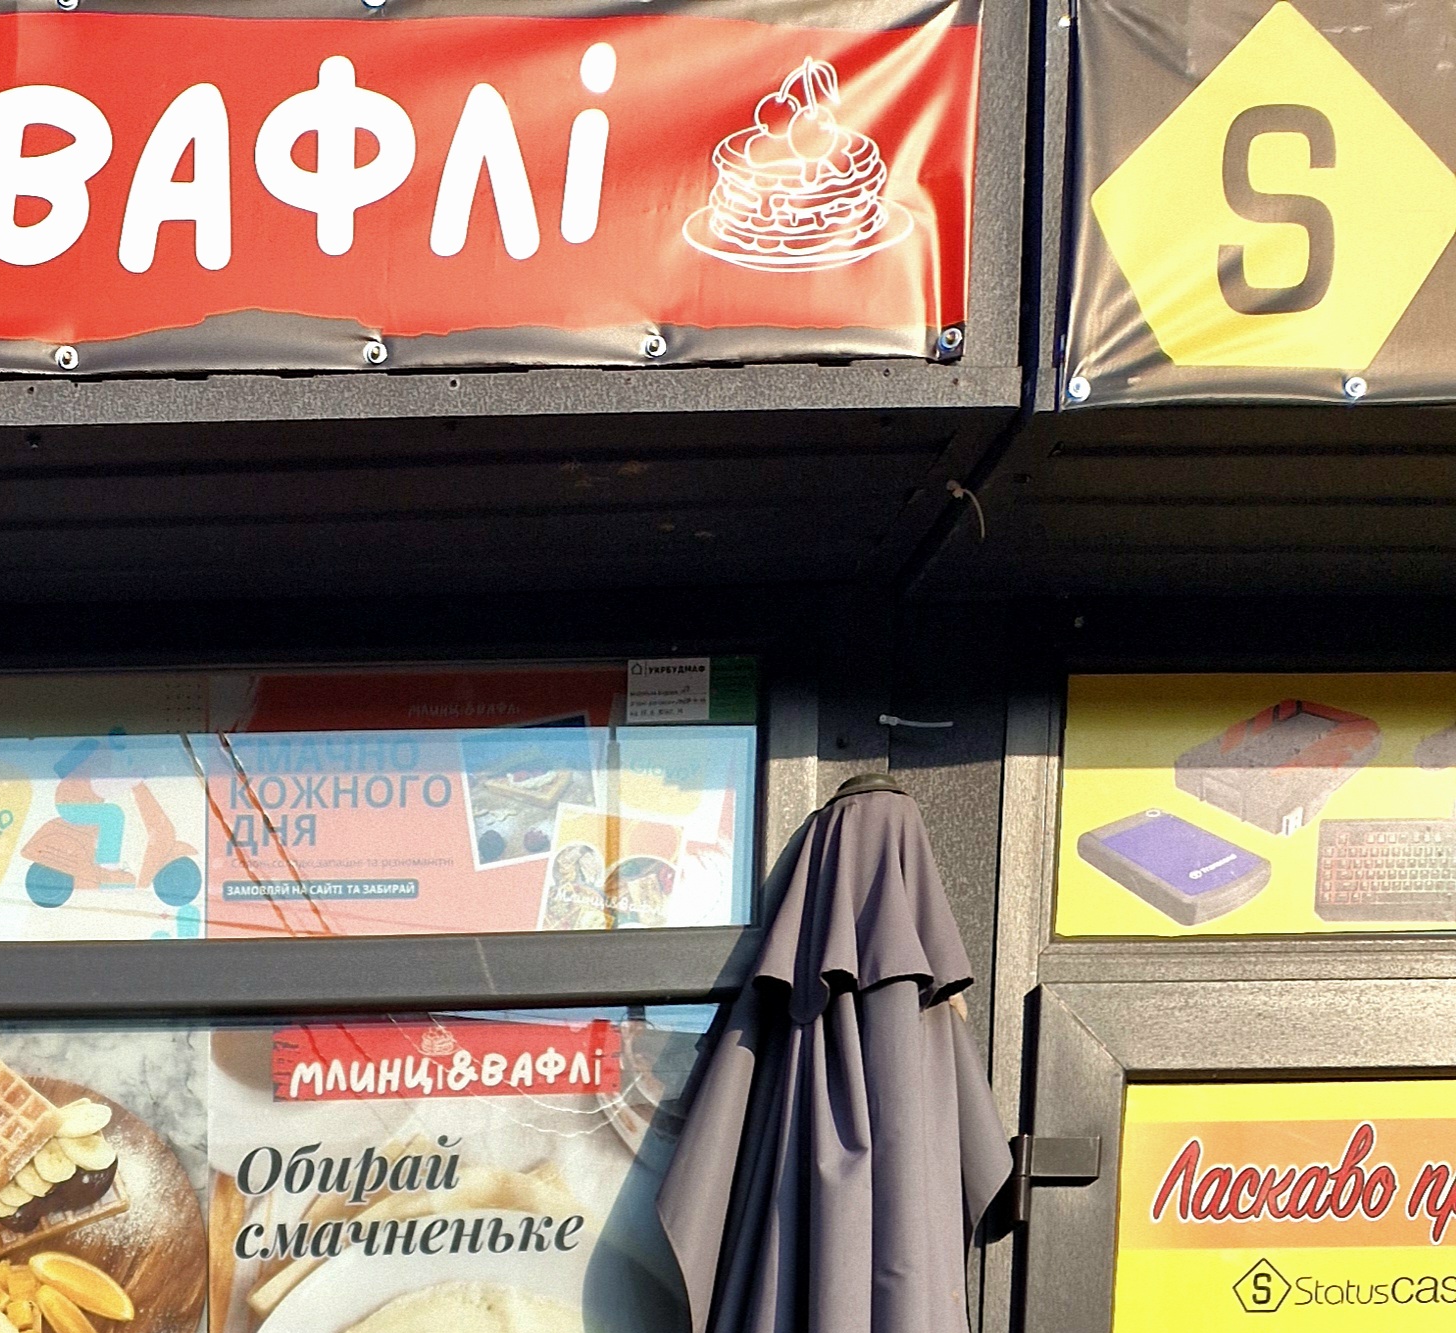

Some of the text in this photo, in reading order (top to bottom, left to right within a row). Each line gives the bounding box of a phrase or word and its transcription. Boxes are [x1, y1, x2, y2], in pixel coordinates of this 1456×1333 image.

[1218, 104, 1336, 316] S
[228, 774, 452, 809] КОЖНОГО
[226, 815, 317, 857] ДНЯ
[226, 880, 415, 896] ЗАМОВЛЯЙ НА САЙТІ ТА ЗАБИРАЙ
[290, 1049, 603, 1098] МЛИНЦІ&ВАФЛІ
[235, 1135, 462, 1203] Обирай
[1152, 1123, 1397, 1220] Ласкаво
[235, 1212, 585, 1259] смачненьке
[1252, 1273, 1272, 1305] S
